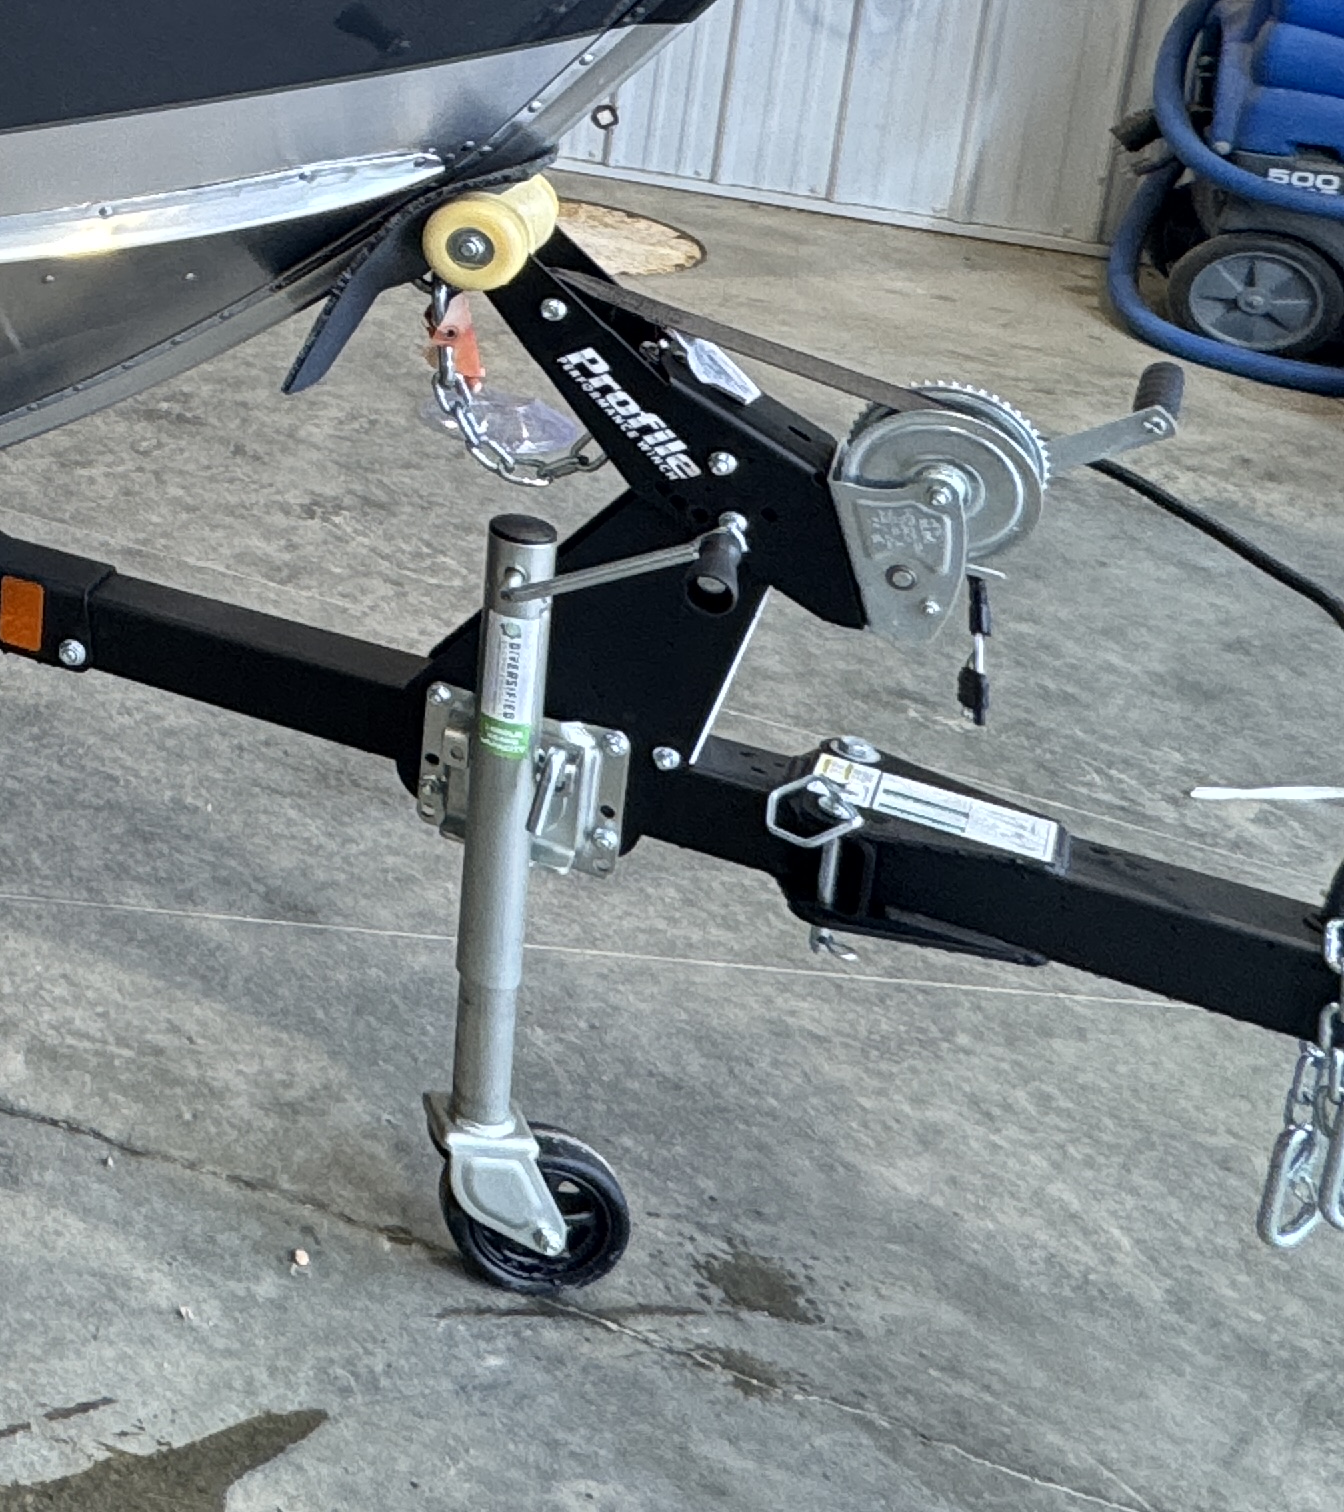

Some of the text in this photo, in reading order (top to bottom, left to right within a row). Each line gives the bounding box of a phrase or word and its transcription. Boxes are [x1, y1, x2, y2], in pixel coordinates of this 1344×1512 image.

[1267, 168, 1340, 190] 500
[556, 355, 680, 481] PERFORMANCE WINCH
[565, 346, 702, 480] Profile
[502, 641, 522, 720] DIVERSIFIED
